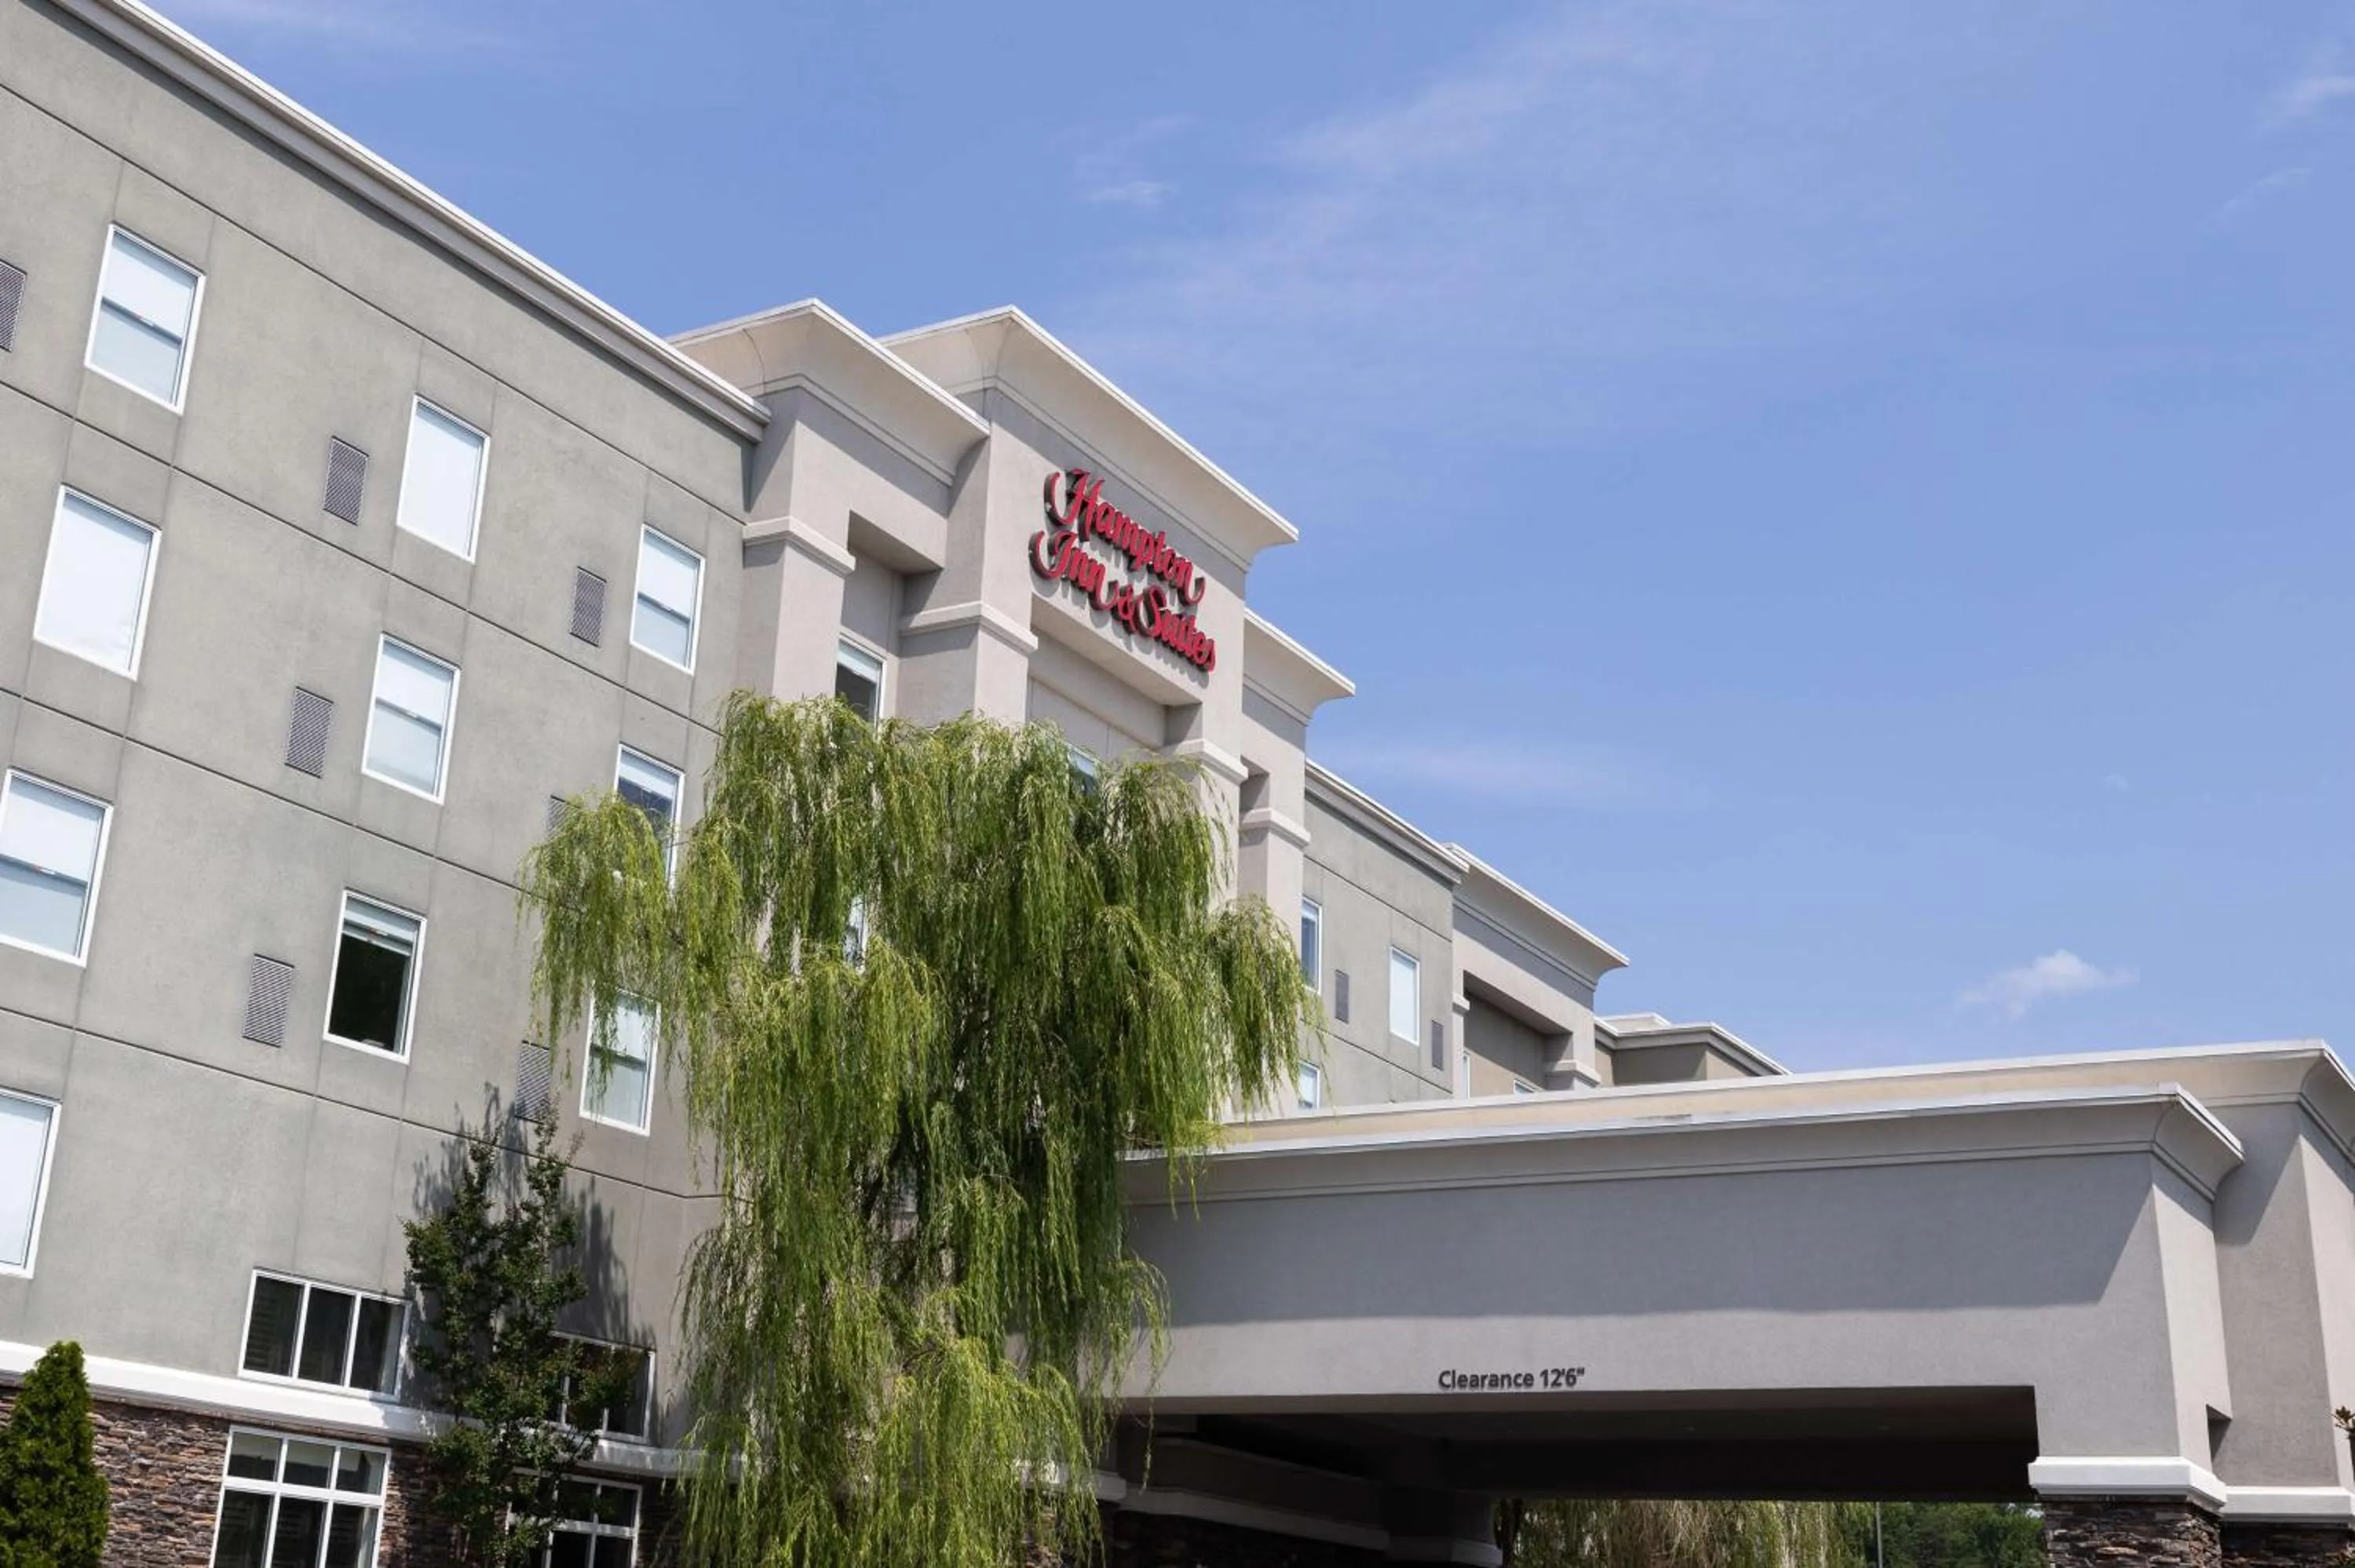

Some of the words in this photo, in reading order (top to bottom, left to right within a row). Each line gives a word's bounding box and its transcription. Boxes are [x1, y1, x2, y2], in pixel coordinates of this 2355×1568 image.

[1028, 531, 1119, 611] Inn
[1112, 584, 1135, 634] &
[1133, 585, 1215, 672] Suites
[1044, 469, 1205, 606] Hampton
[1438, 1369, 1535, 1389] Clearance
[1539, 1367, 1585, 1388] 12'6"
